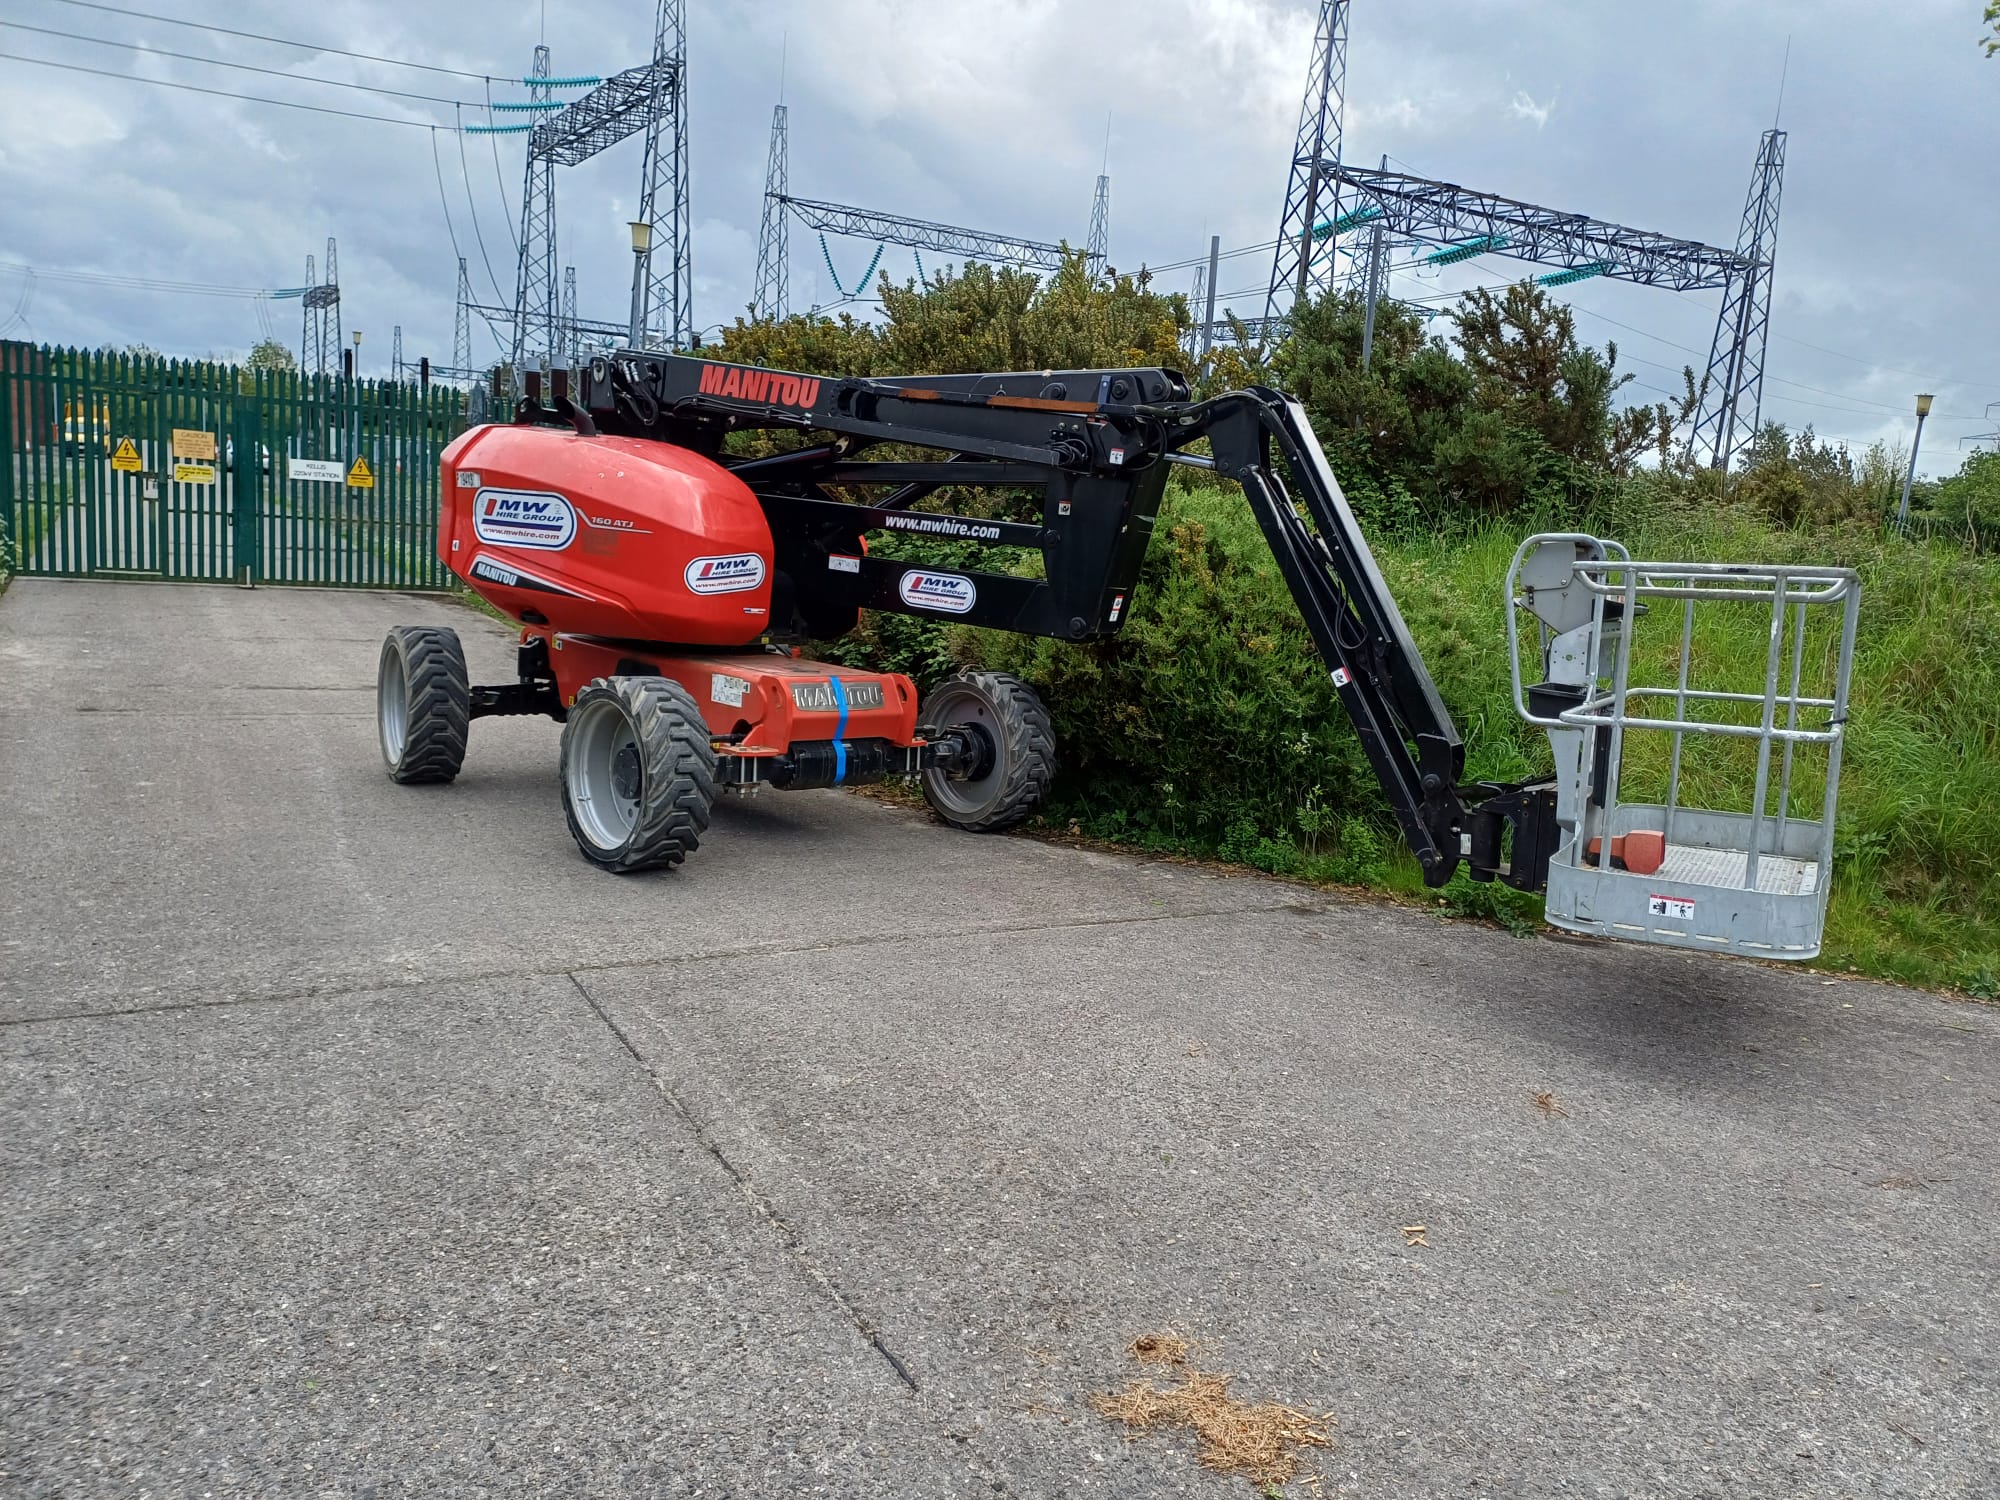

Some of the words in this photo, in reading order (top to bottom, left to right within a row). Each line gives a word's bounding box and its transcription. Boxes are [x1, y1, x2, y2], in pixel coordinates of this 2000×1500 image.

[698, 364, 821, 409] MANITOU
[499, 499, 551, 513] MW
[495, 511, 520, 519] HIRE
[522, 514, 564, 522] GROUP
[591, 516, 612, 525] 160
[613, 519, 634, 528] ATJ
[885, 515, 1000, 539] www.mwhire.com
[483, 527, 560, 540] www.mwhire.com
[714, 558, 751, 570] MW
[476, 562, 518, 586] MANITOU
[695, 578, 756, 588] www.mwhire.com
[924, 577, 961, 589] MW
[940, 588, 968, 596] GROUP
[906, 594, 965, 607] www.mwhire.com
